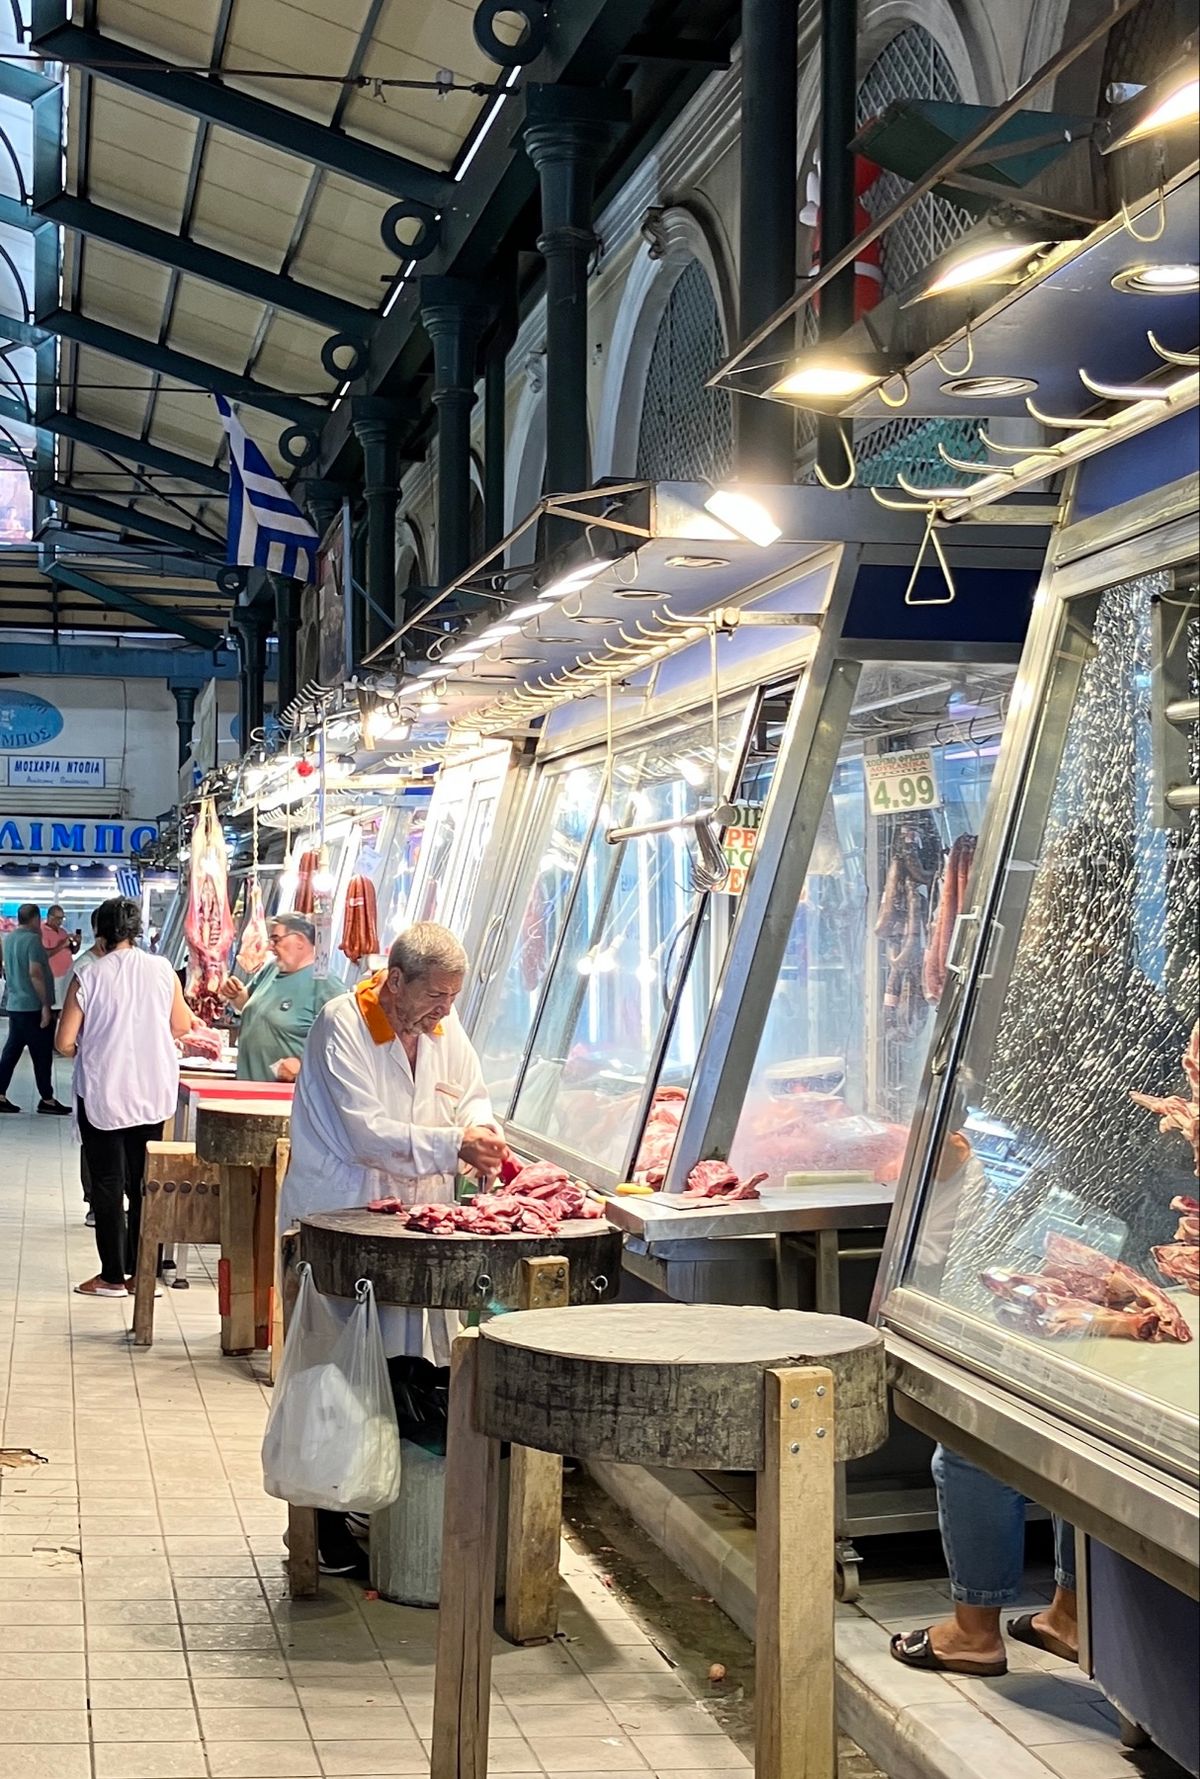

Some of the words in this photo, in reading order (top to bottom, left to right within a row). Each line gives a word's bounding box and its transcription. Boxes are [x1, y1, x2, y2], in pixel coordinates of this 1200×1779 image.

[14, 760, 60, 772] ΜΟΣΧΑΡΙΑ
[67, 761, 100, 774] ΝΤΟΠΙΑ
[874, 775, 934, 809] 4.99
